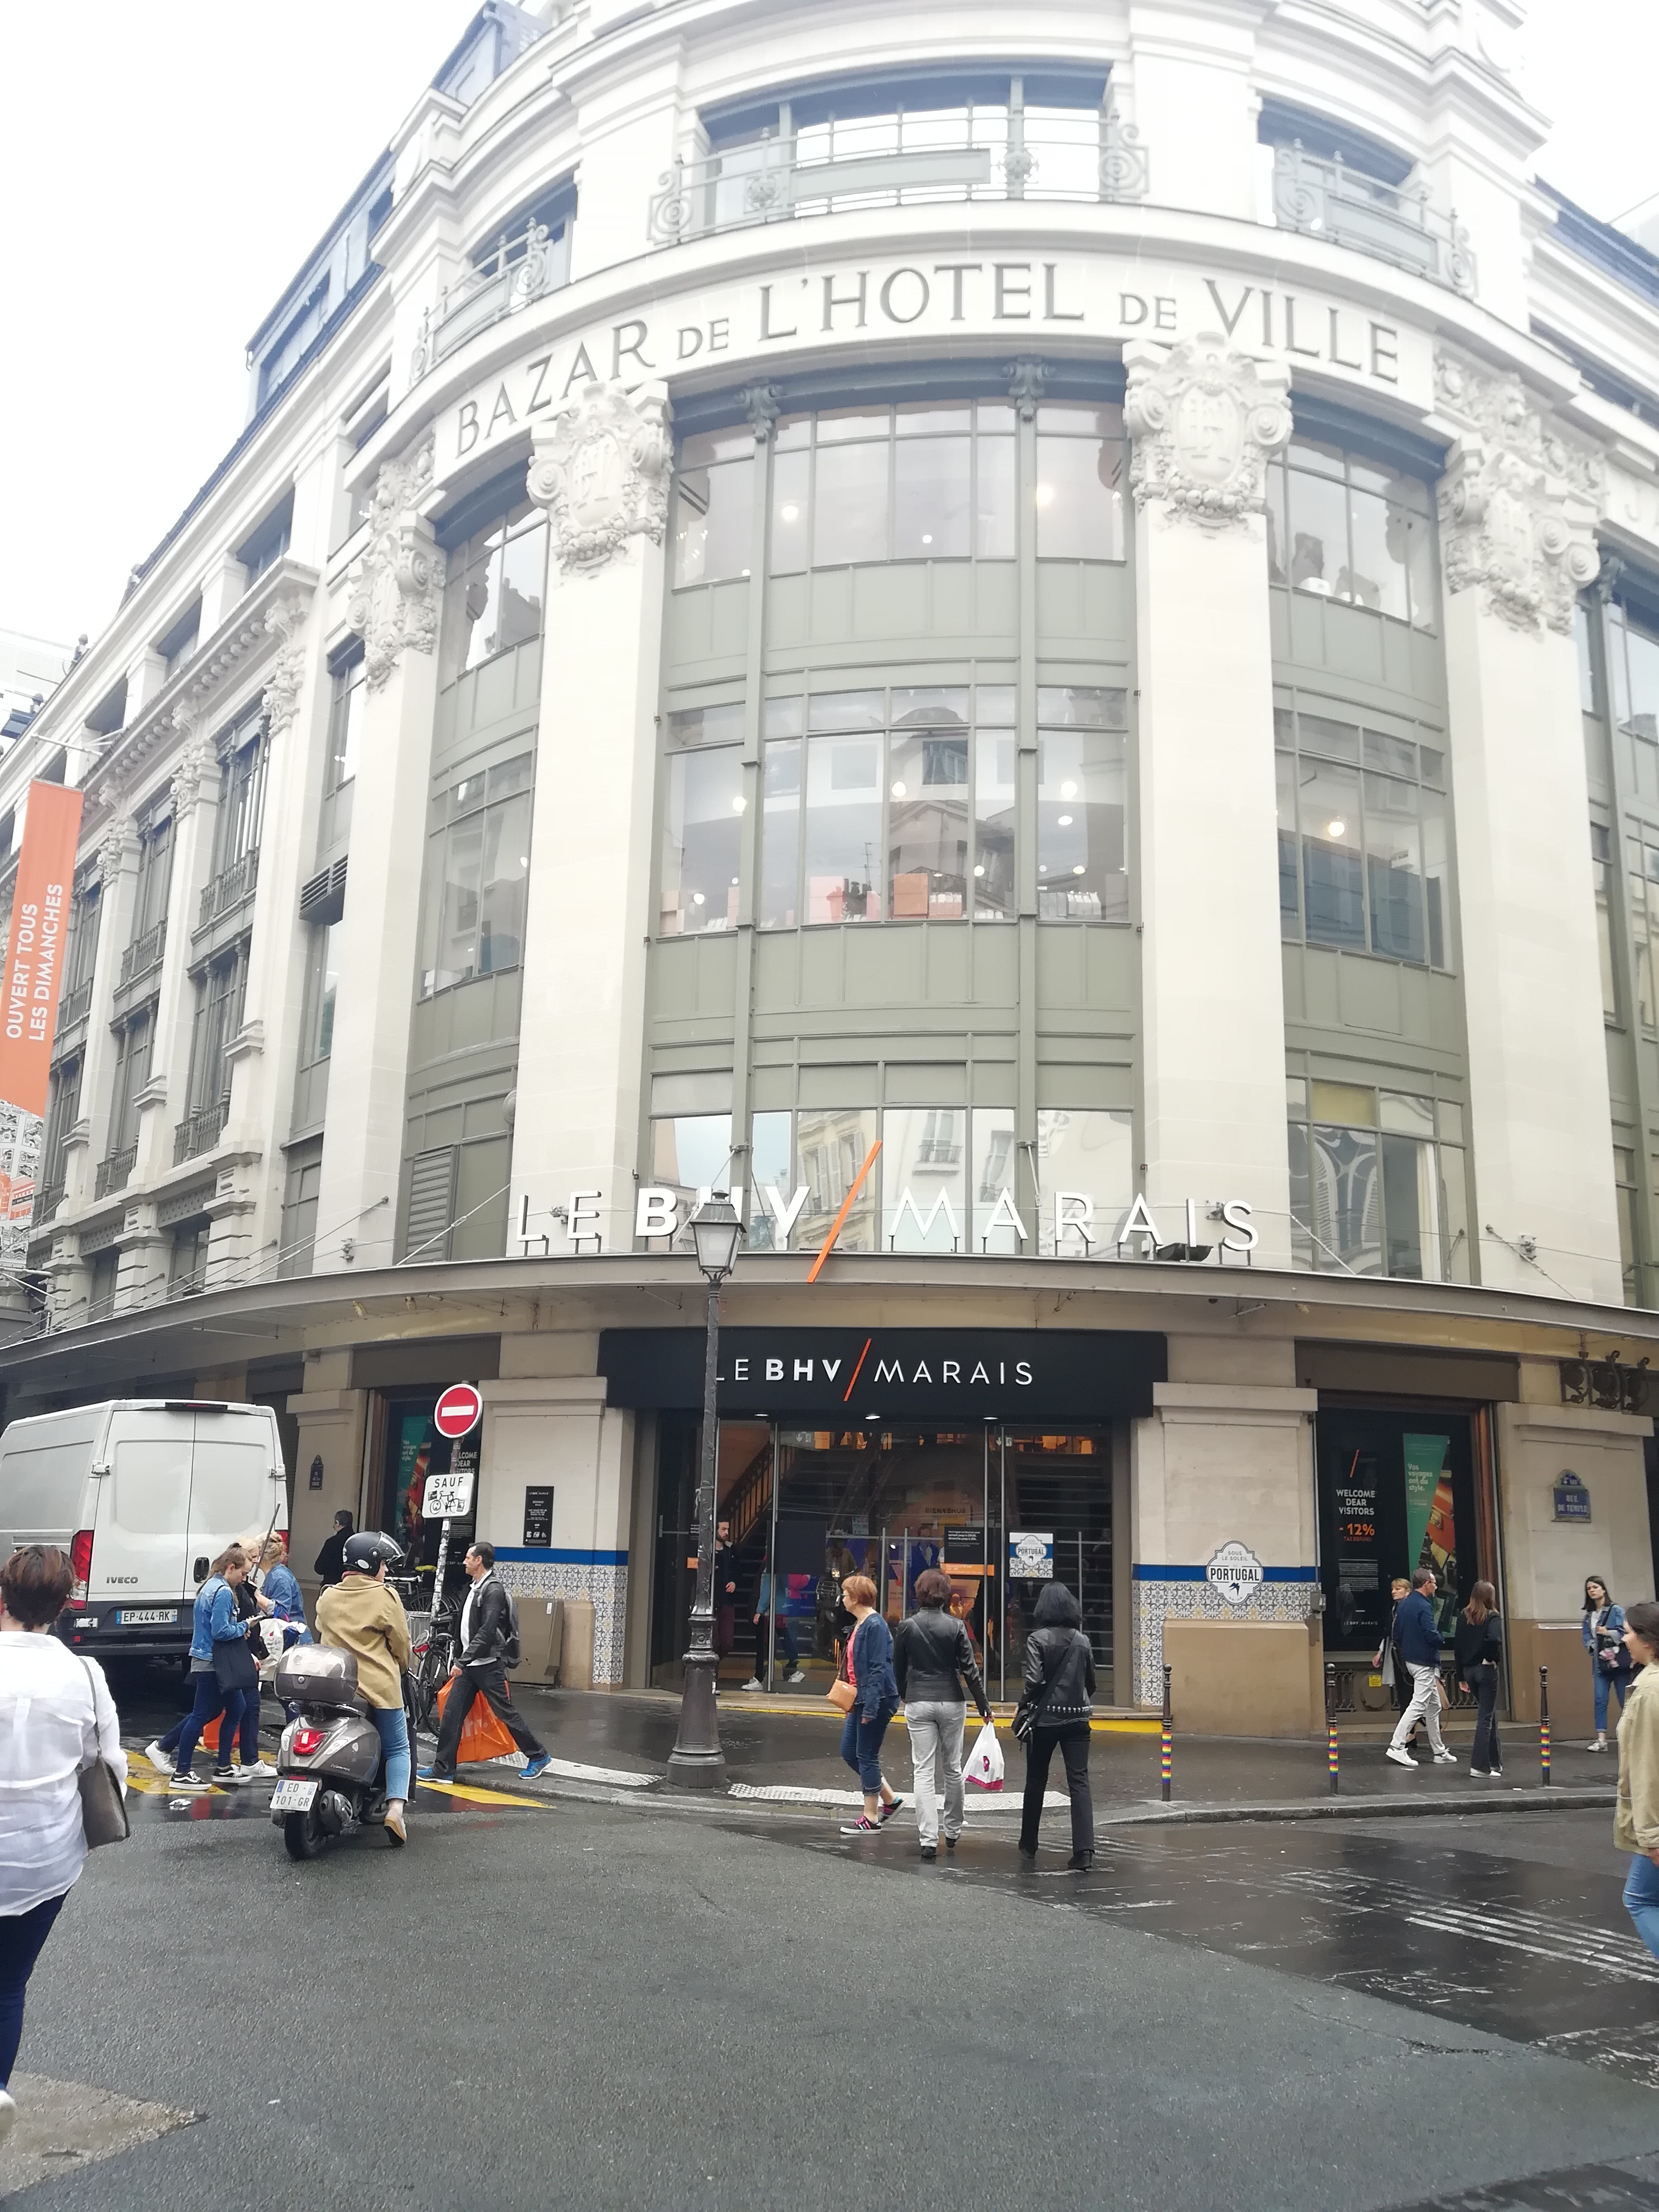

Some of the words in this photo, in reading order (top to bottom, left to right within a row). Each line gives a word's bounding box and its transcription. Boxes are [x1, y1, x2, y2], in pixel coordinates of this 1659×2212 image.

[454, 318, 656, 459] BAZAR
[676, 317, 730, 361] DE
[758, 261, 1086, 342] L'HOTEL
[1118, 292, 1177, 330] DE
[1202, 278, 1399, 384] VILLE
[16, 904, 37, 957] TOUS
[34, 884, 63, 1001] DIMANCHES
[6, 959, 30, 1039] OUVERT
[28, 1006, 48, 1041] LES
[516, 1190, 603, 1243] LE
[888, 1185, 1260, 1251] MARAIS
[716, 1359, 749, 1381] E
[765, 1359, 842, 1382] BHV
[874, 1359, 1033, 1386] MARAIS
[434, 1476, 464, 1488] SAUF
[1336, 1489, 1376, 1498] WELCOME
[1346, 1498, 1367, 1506] DEAR
[1338, 1507, 1375, 1515] VISITORS
[1347, 1522, 1375, 1536] 12%
[1210, 1568, 1260, 1581] PORTUGAL
[276, 1795, 310, 1807] 101-GR
